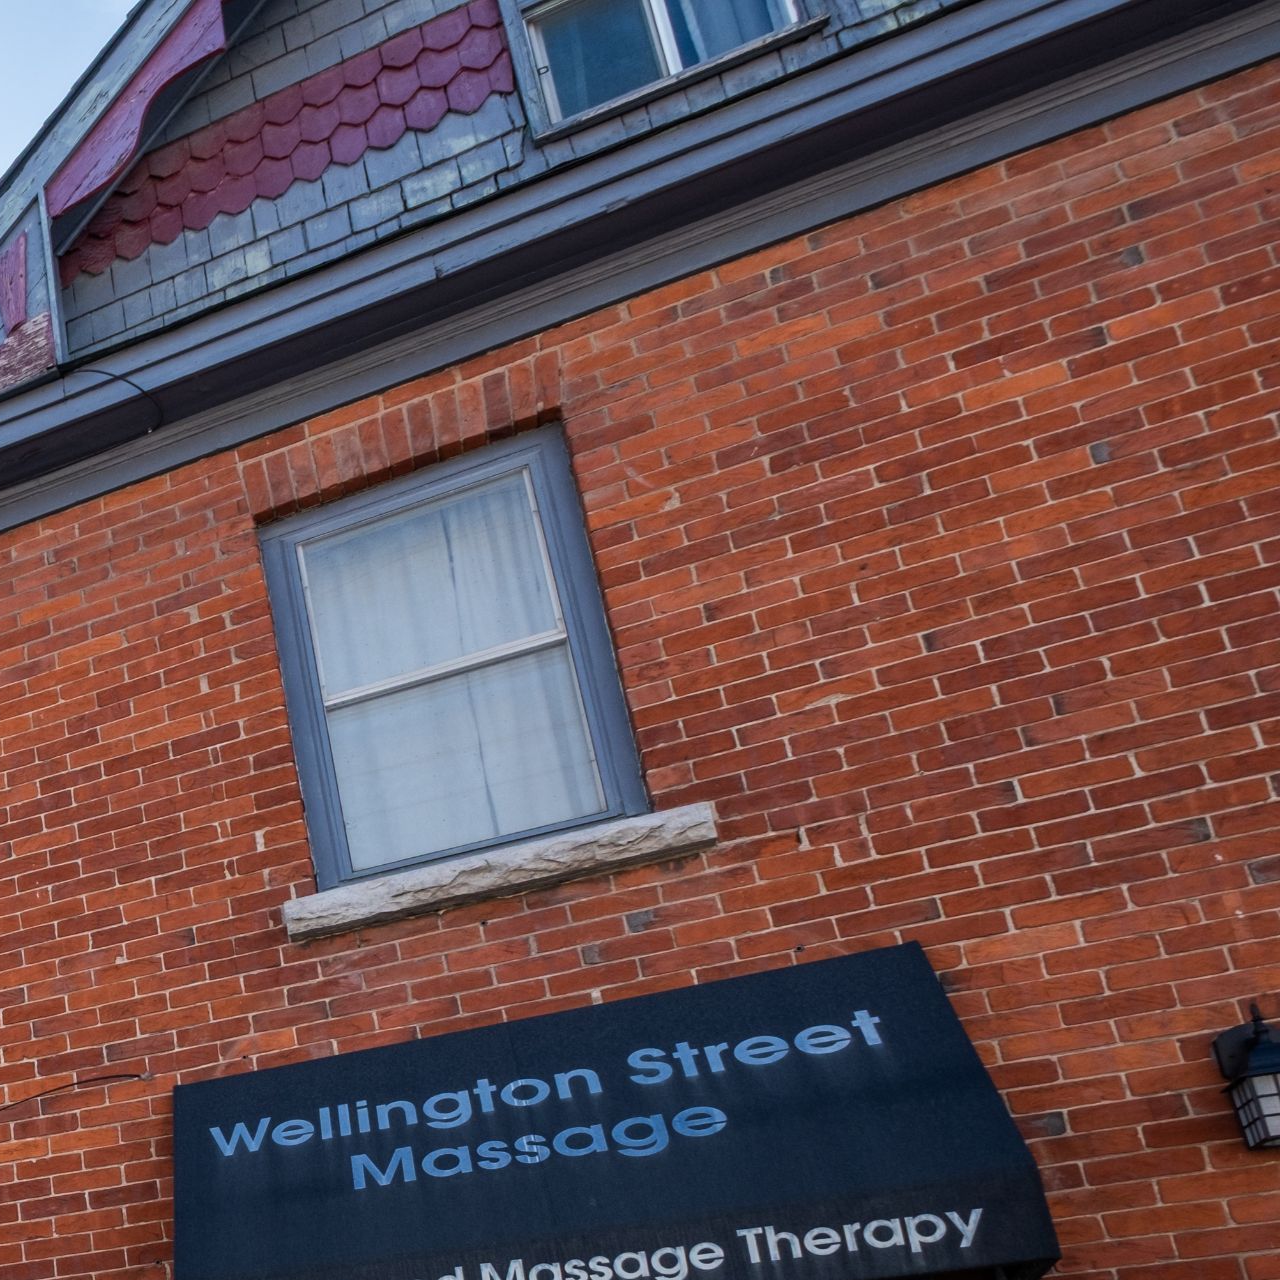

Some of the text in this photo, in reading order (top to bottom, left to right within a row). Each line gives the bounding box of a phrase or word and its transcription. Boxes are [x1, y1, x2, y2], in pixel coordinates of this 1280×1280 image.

[209, 1009, 883, 1157] Wellington Street
[350, 1106, 728, 1190] Massage
[735, 1207, 984, 1264] Therapy
